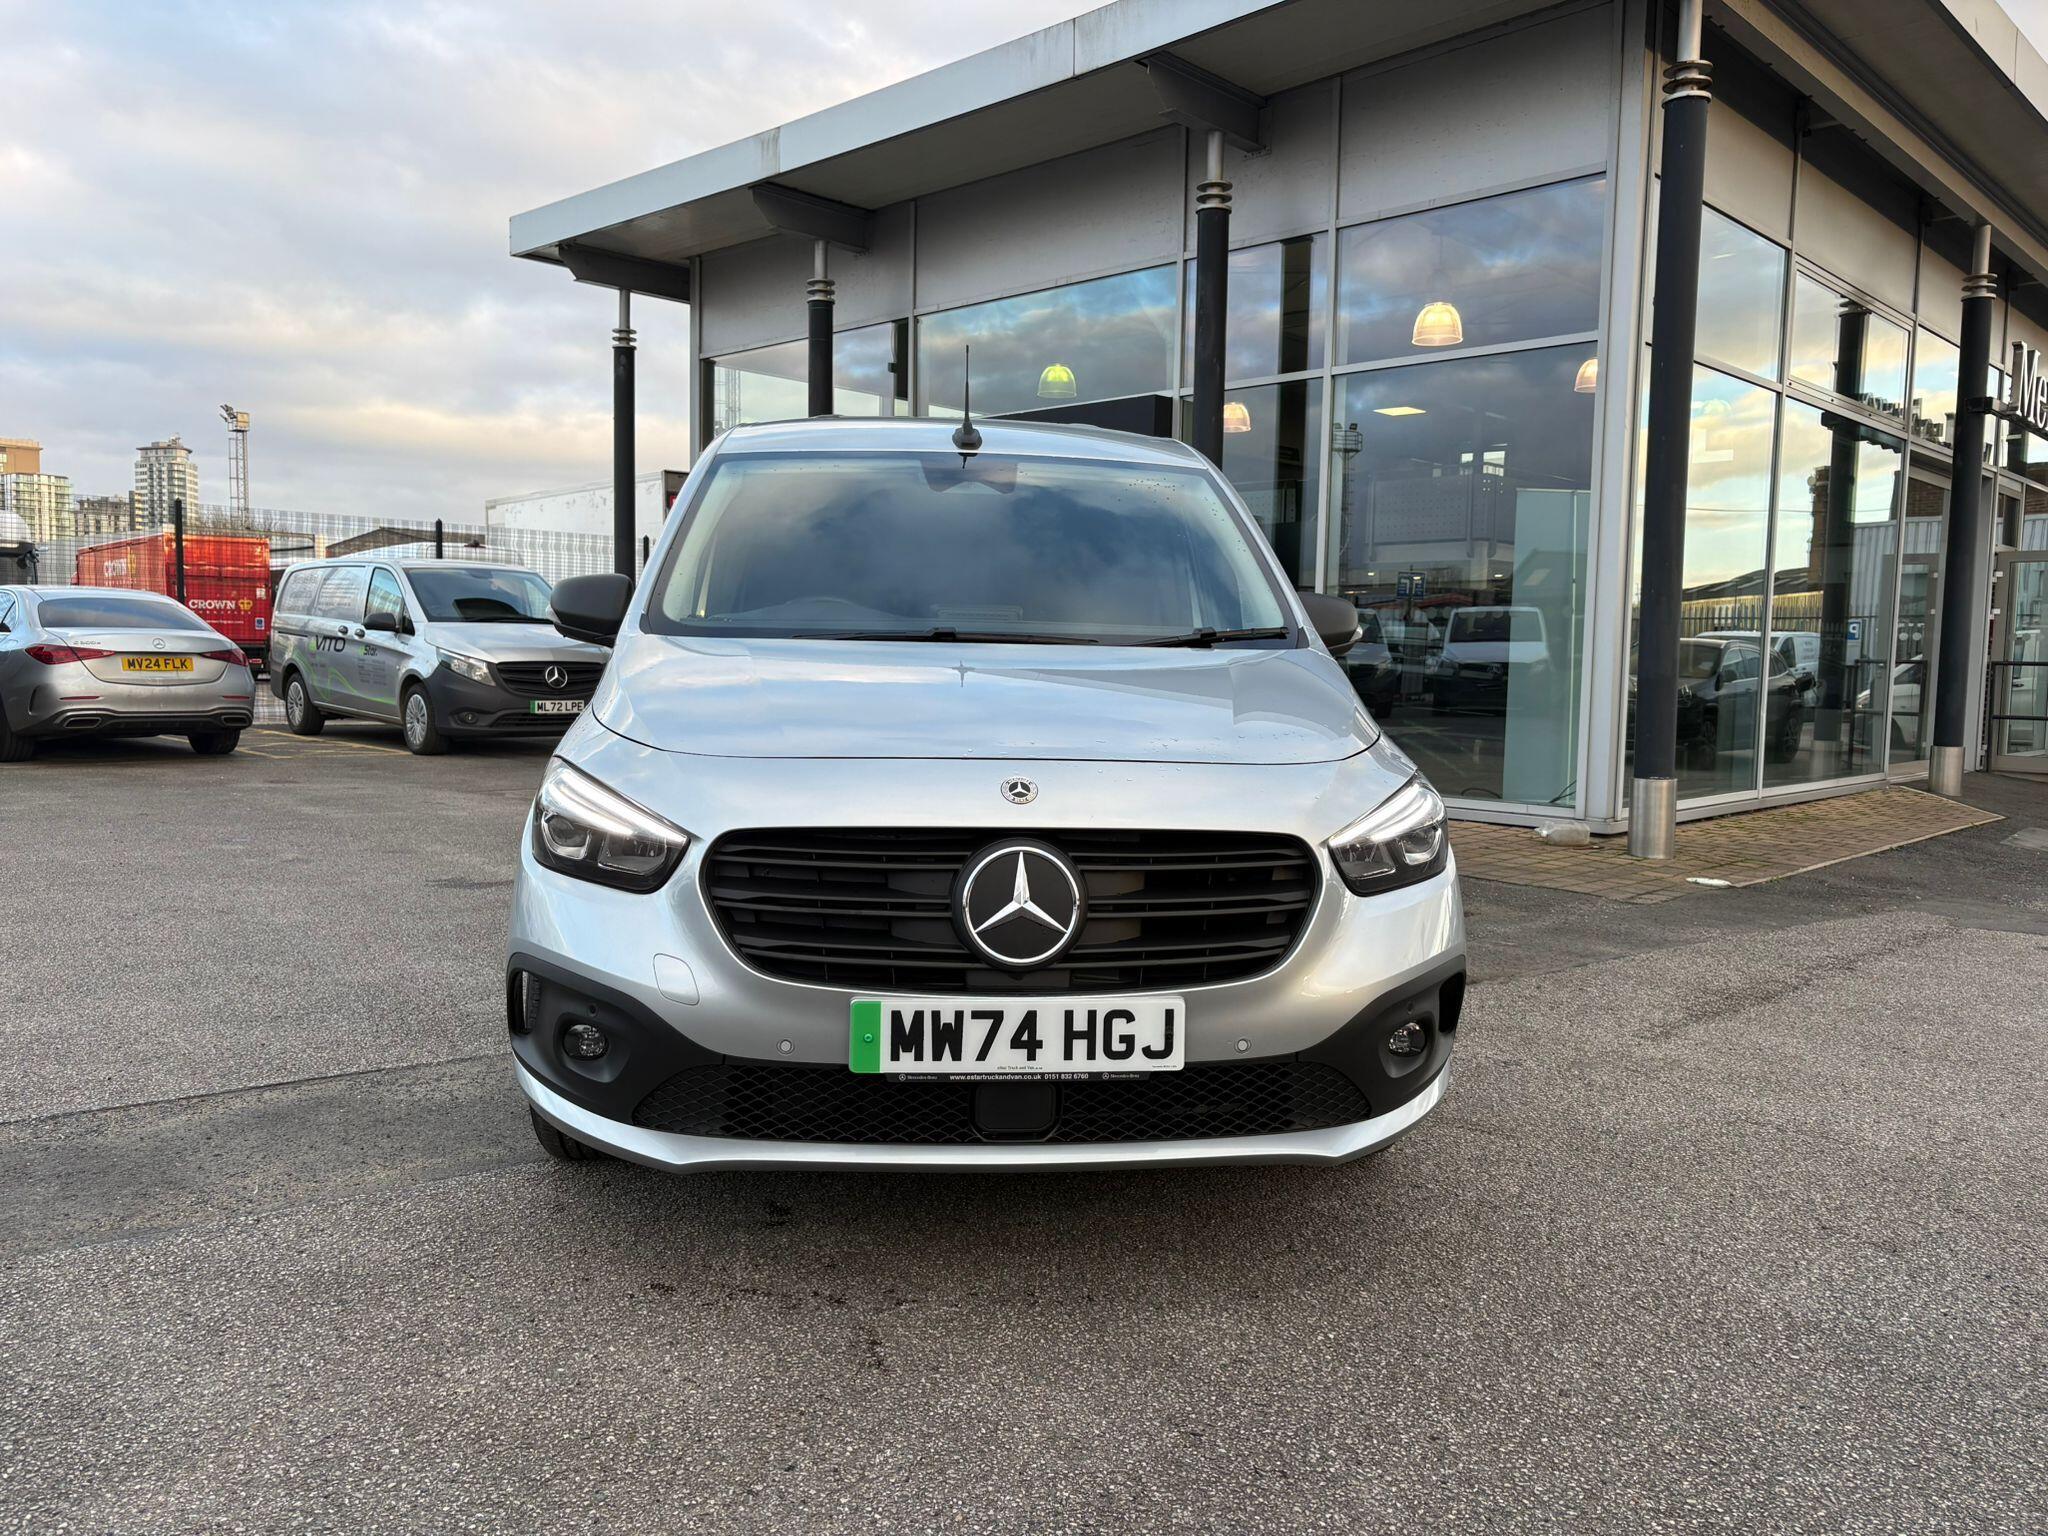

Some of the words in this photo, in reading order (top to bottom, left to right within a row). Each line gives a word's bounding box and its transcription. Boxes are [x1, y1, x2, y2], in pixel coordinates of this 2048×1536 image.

[189, 599, 235, 609] CROWN
[127, 659, 161, 669] MV24
[164, 659, 188, 669] FLK
[536, 702, 563, 711] ML72
[565, 702, 583, 711] LPE
[890, 1010, 1043, 1061] MW74
[1063, 1009, 1174, 1060] HGJ
